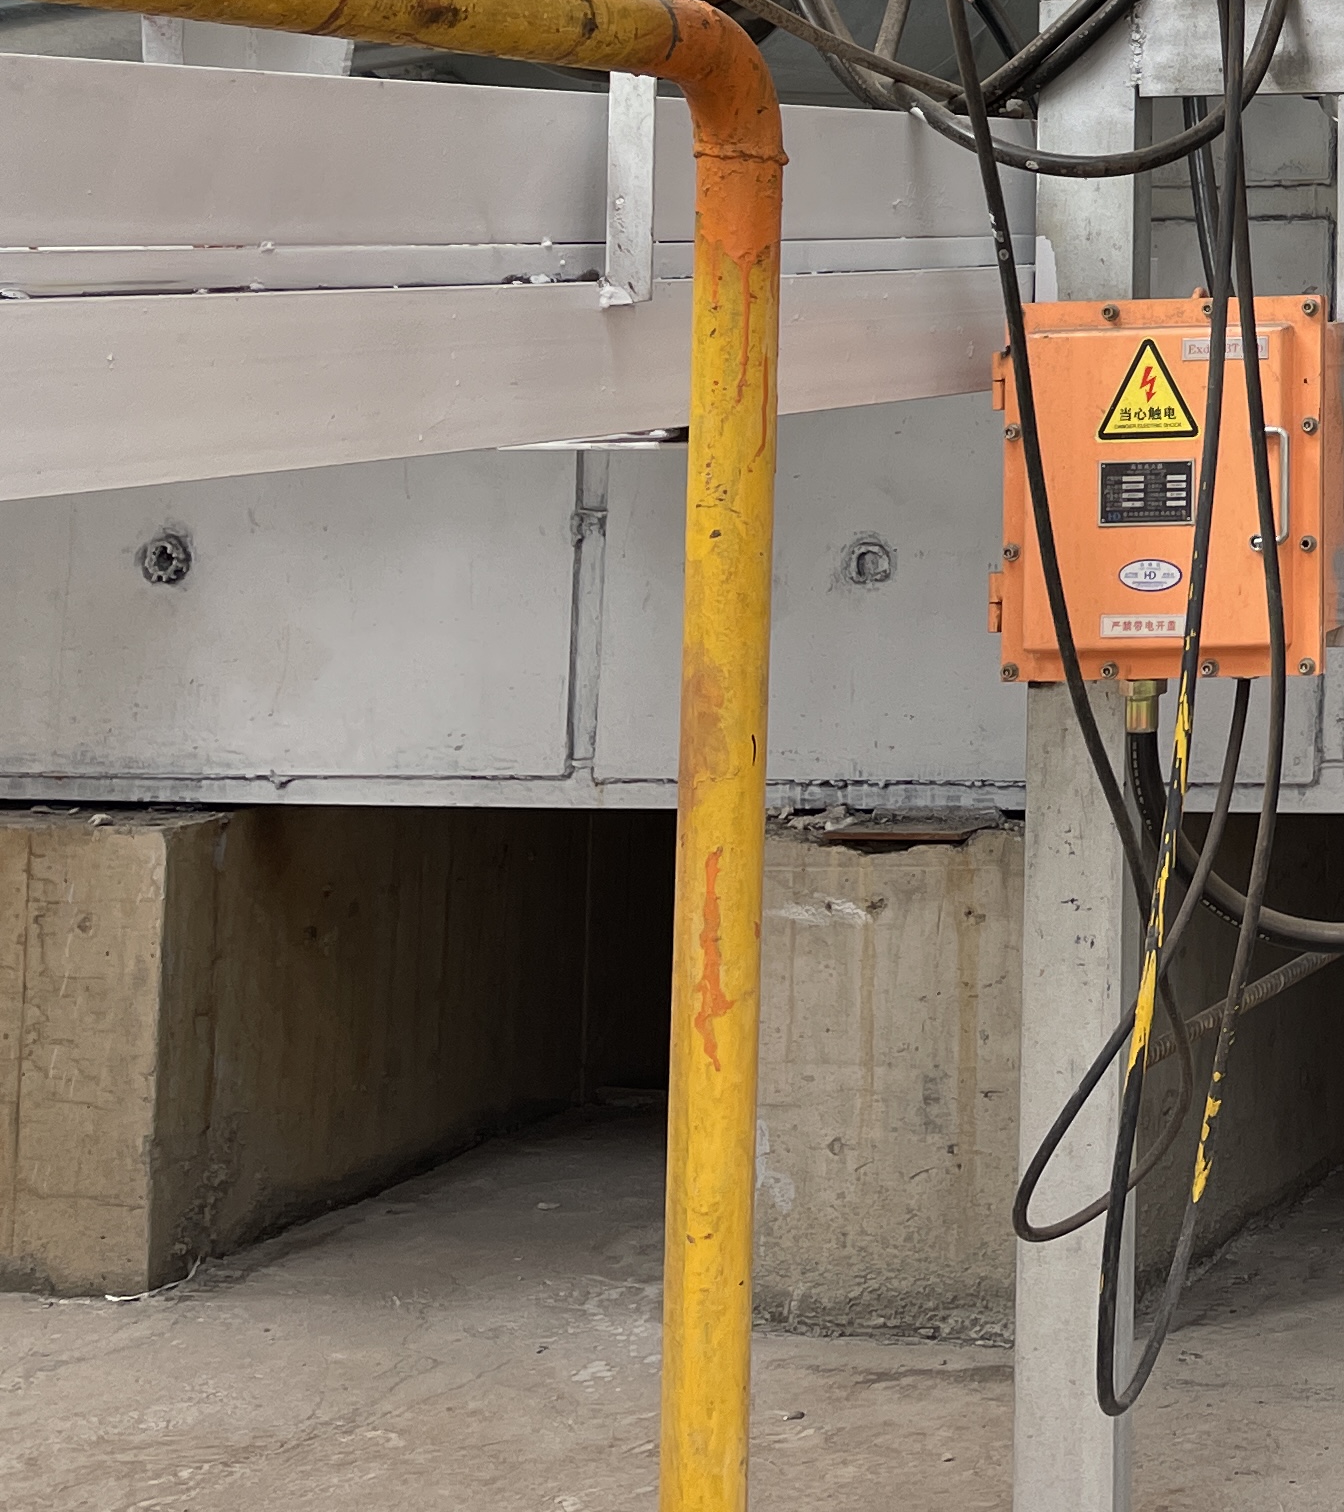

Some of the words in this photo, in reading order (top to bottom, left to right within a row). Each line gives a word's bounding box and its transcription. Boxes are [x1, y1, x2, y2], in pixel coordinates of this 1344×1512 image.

[1119, 405, 1177, 422] 当心触电
[1111, 620, 1177, 632] 严禁带电开盖
